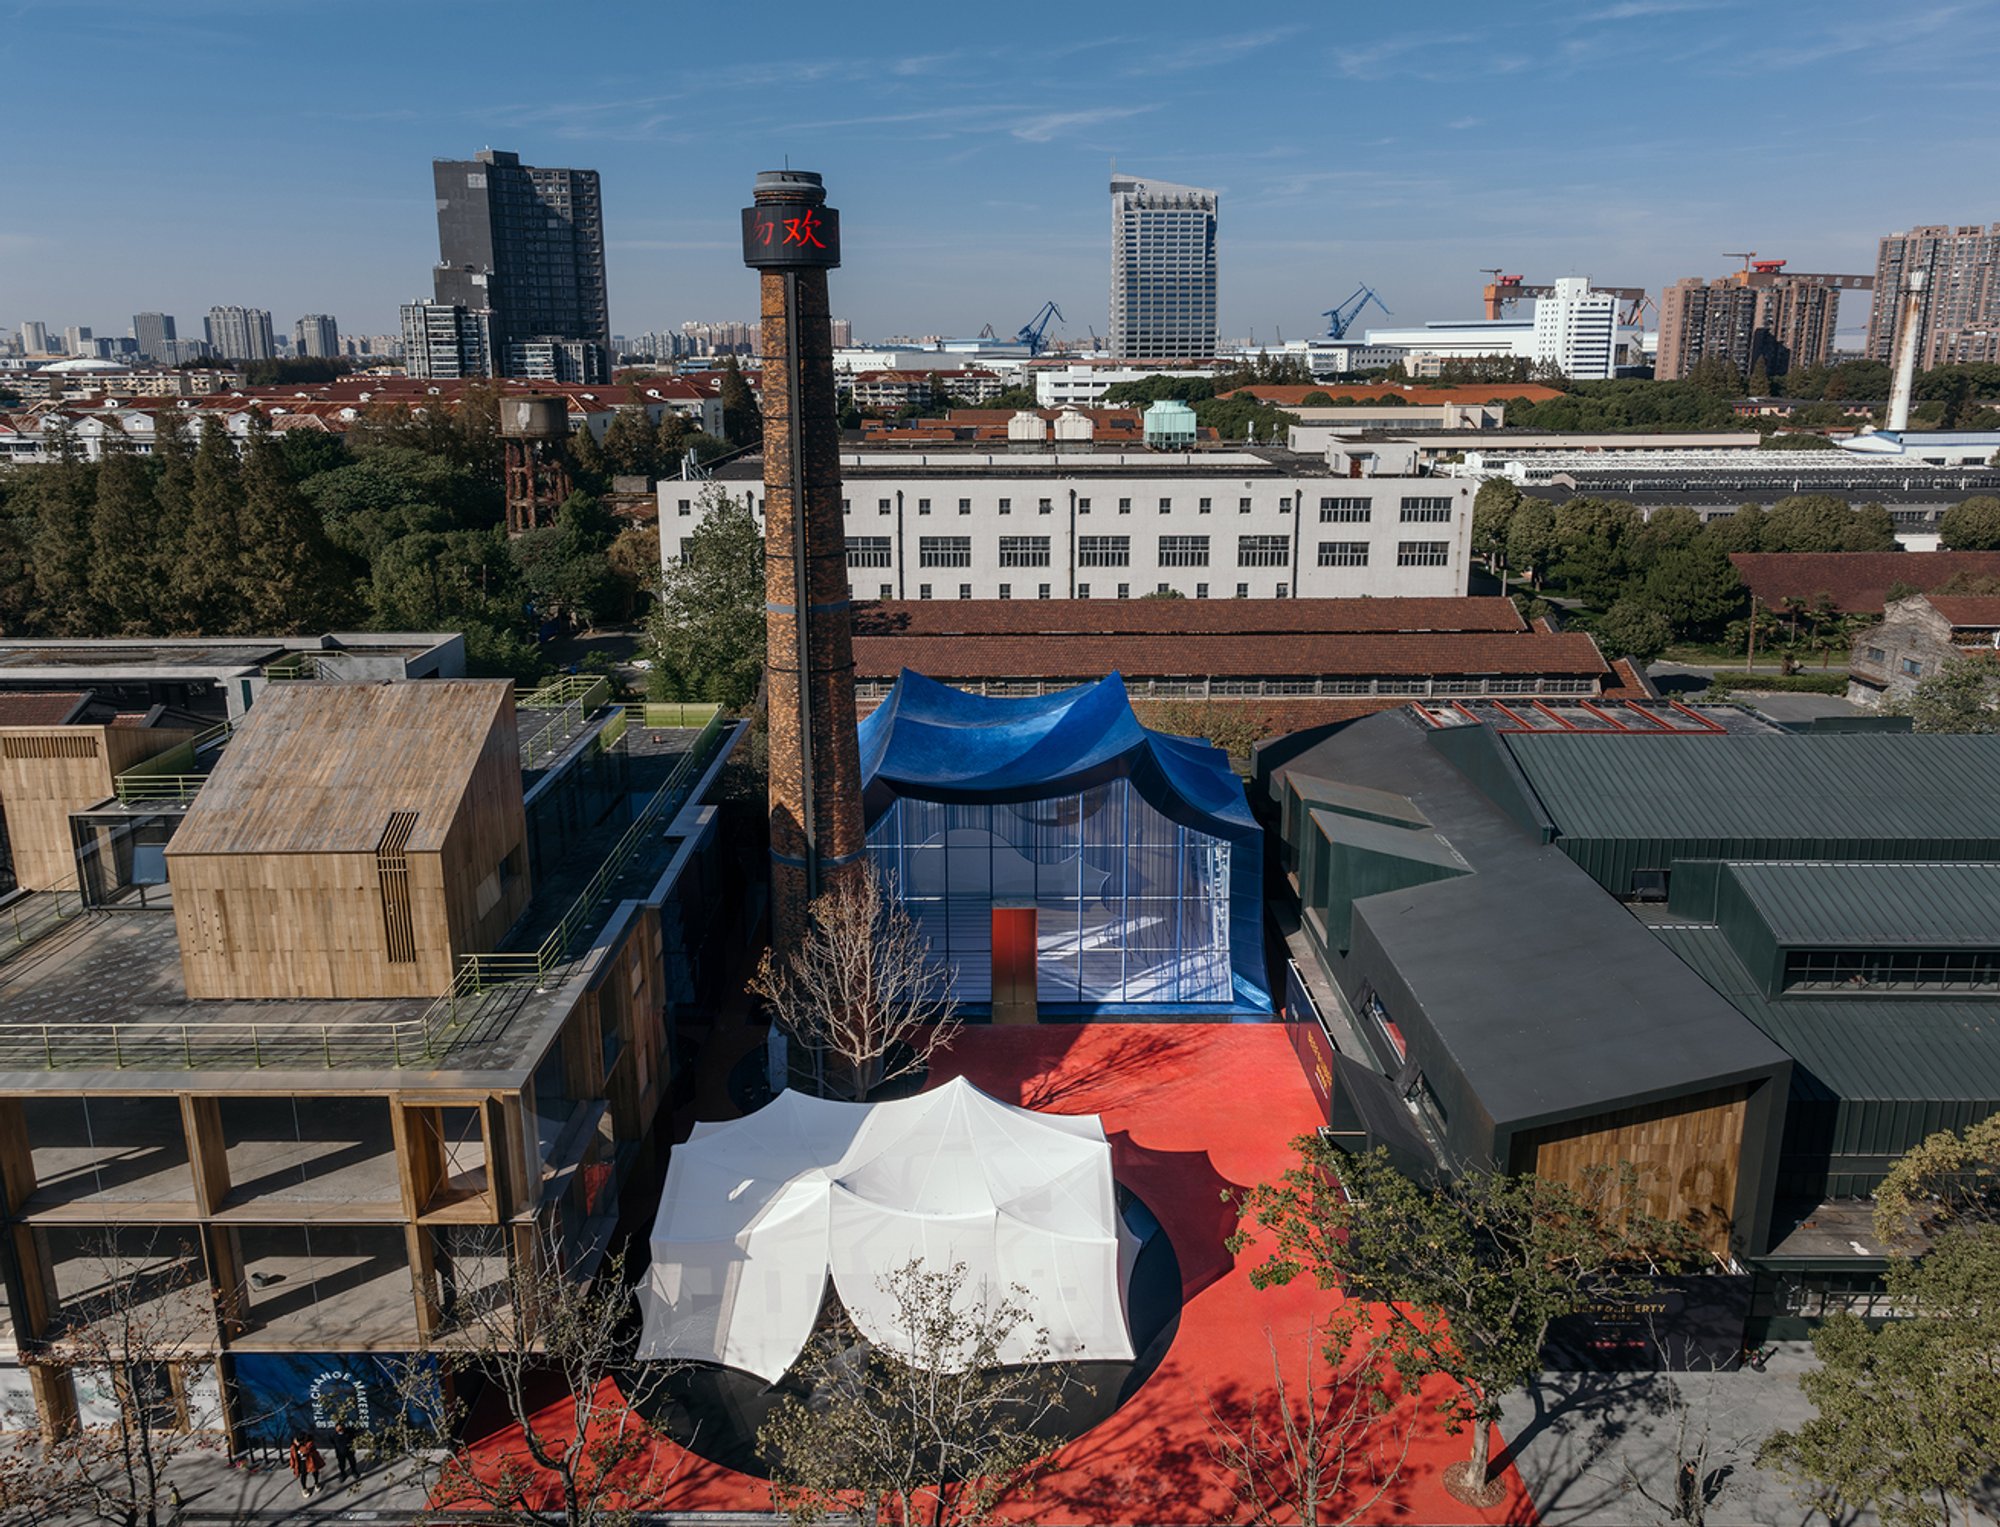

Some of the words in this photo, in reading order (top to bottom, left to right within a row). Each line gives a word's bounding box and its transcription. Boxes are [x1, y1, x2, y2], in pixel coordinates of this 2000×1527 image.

[310, 1371, 352, 1399] CHANGE
[312, 1402, 324, 1420] THE
[353, 1381, 370, 1421] MAKERS
